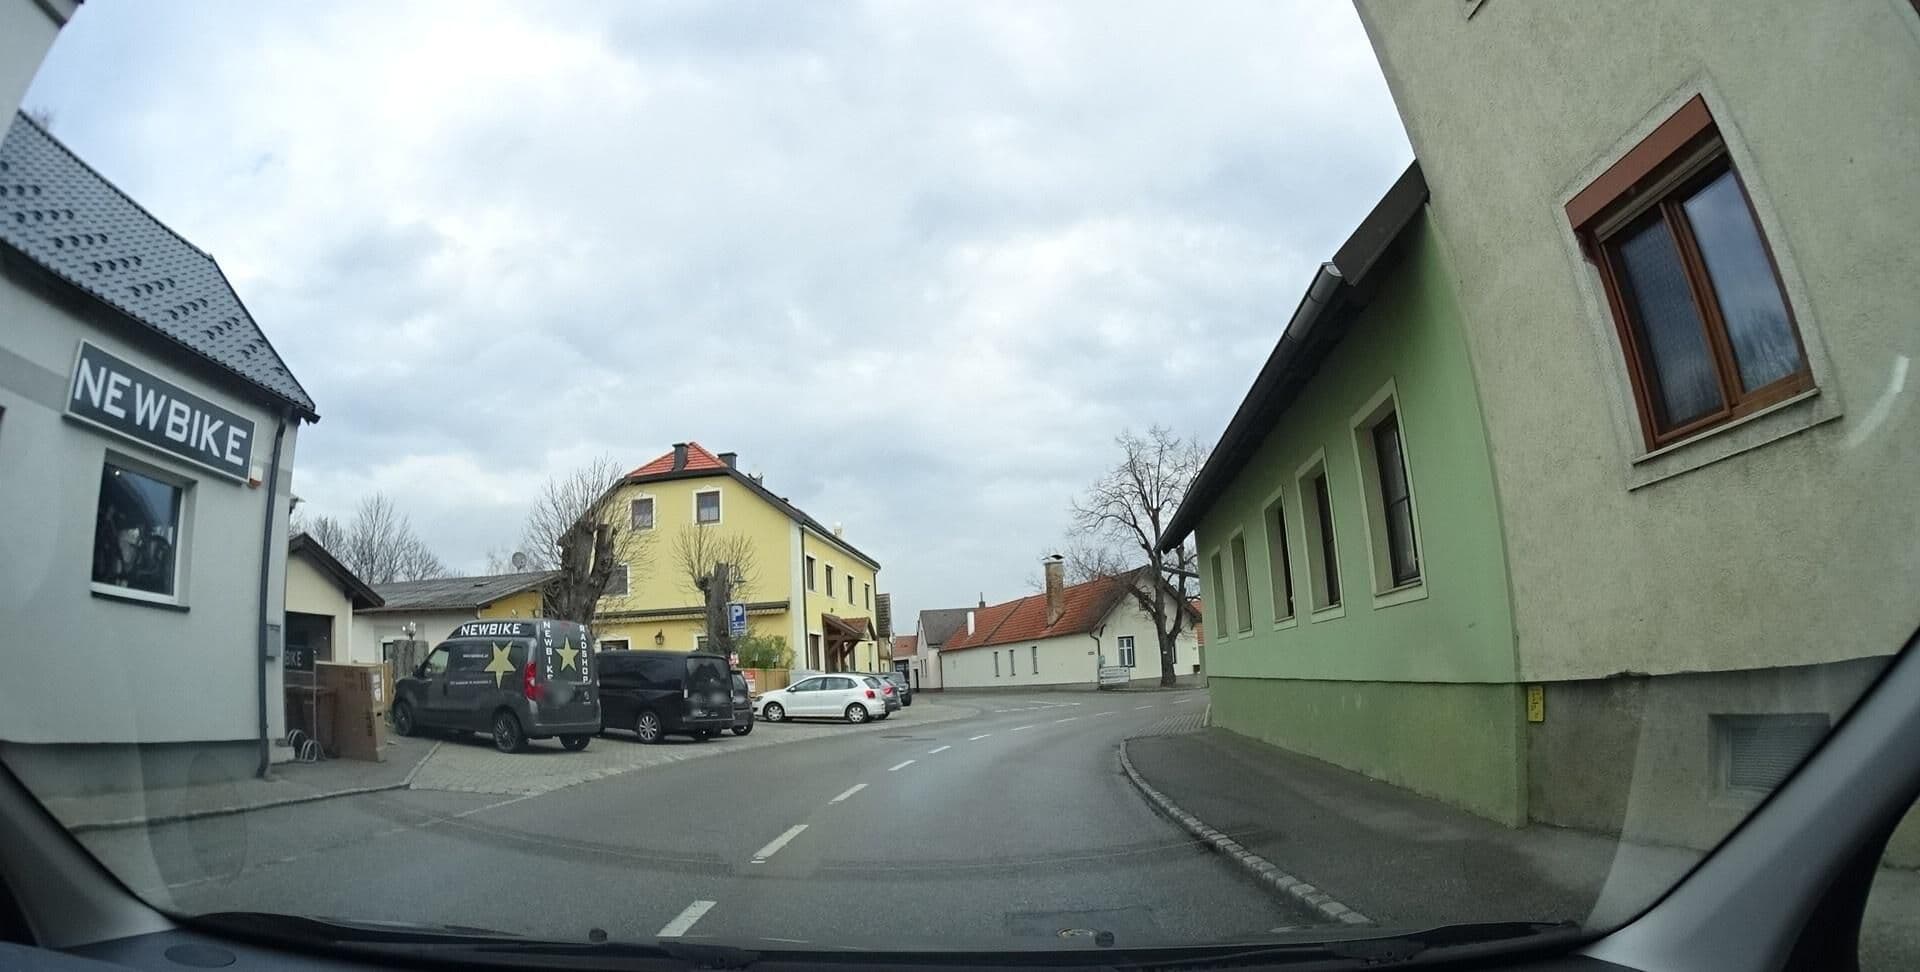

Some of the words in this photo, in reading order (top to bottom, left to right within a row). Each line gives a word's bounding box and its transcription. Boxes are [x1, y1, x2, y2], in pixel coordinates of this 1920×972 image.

[74, 358, 248, 466] NEWBIKE
[461, 622, 522, 636] NEWBIKE
[732, 605, 743, 621] P
[543, 620, 554, 680] NEWBIKE
[579, 624, 589, 684] RADSHOP
